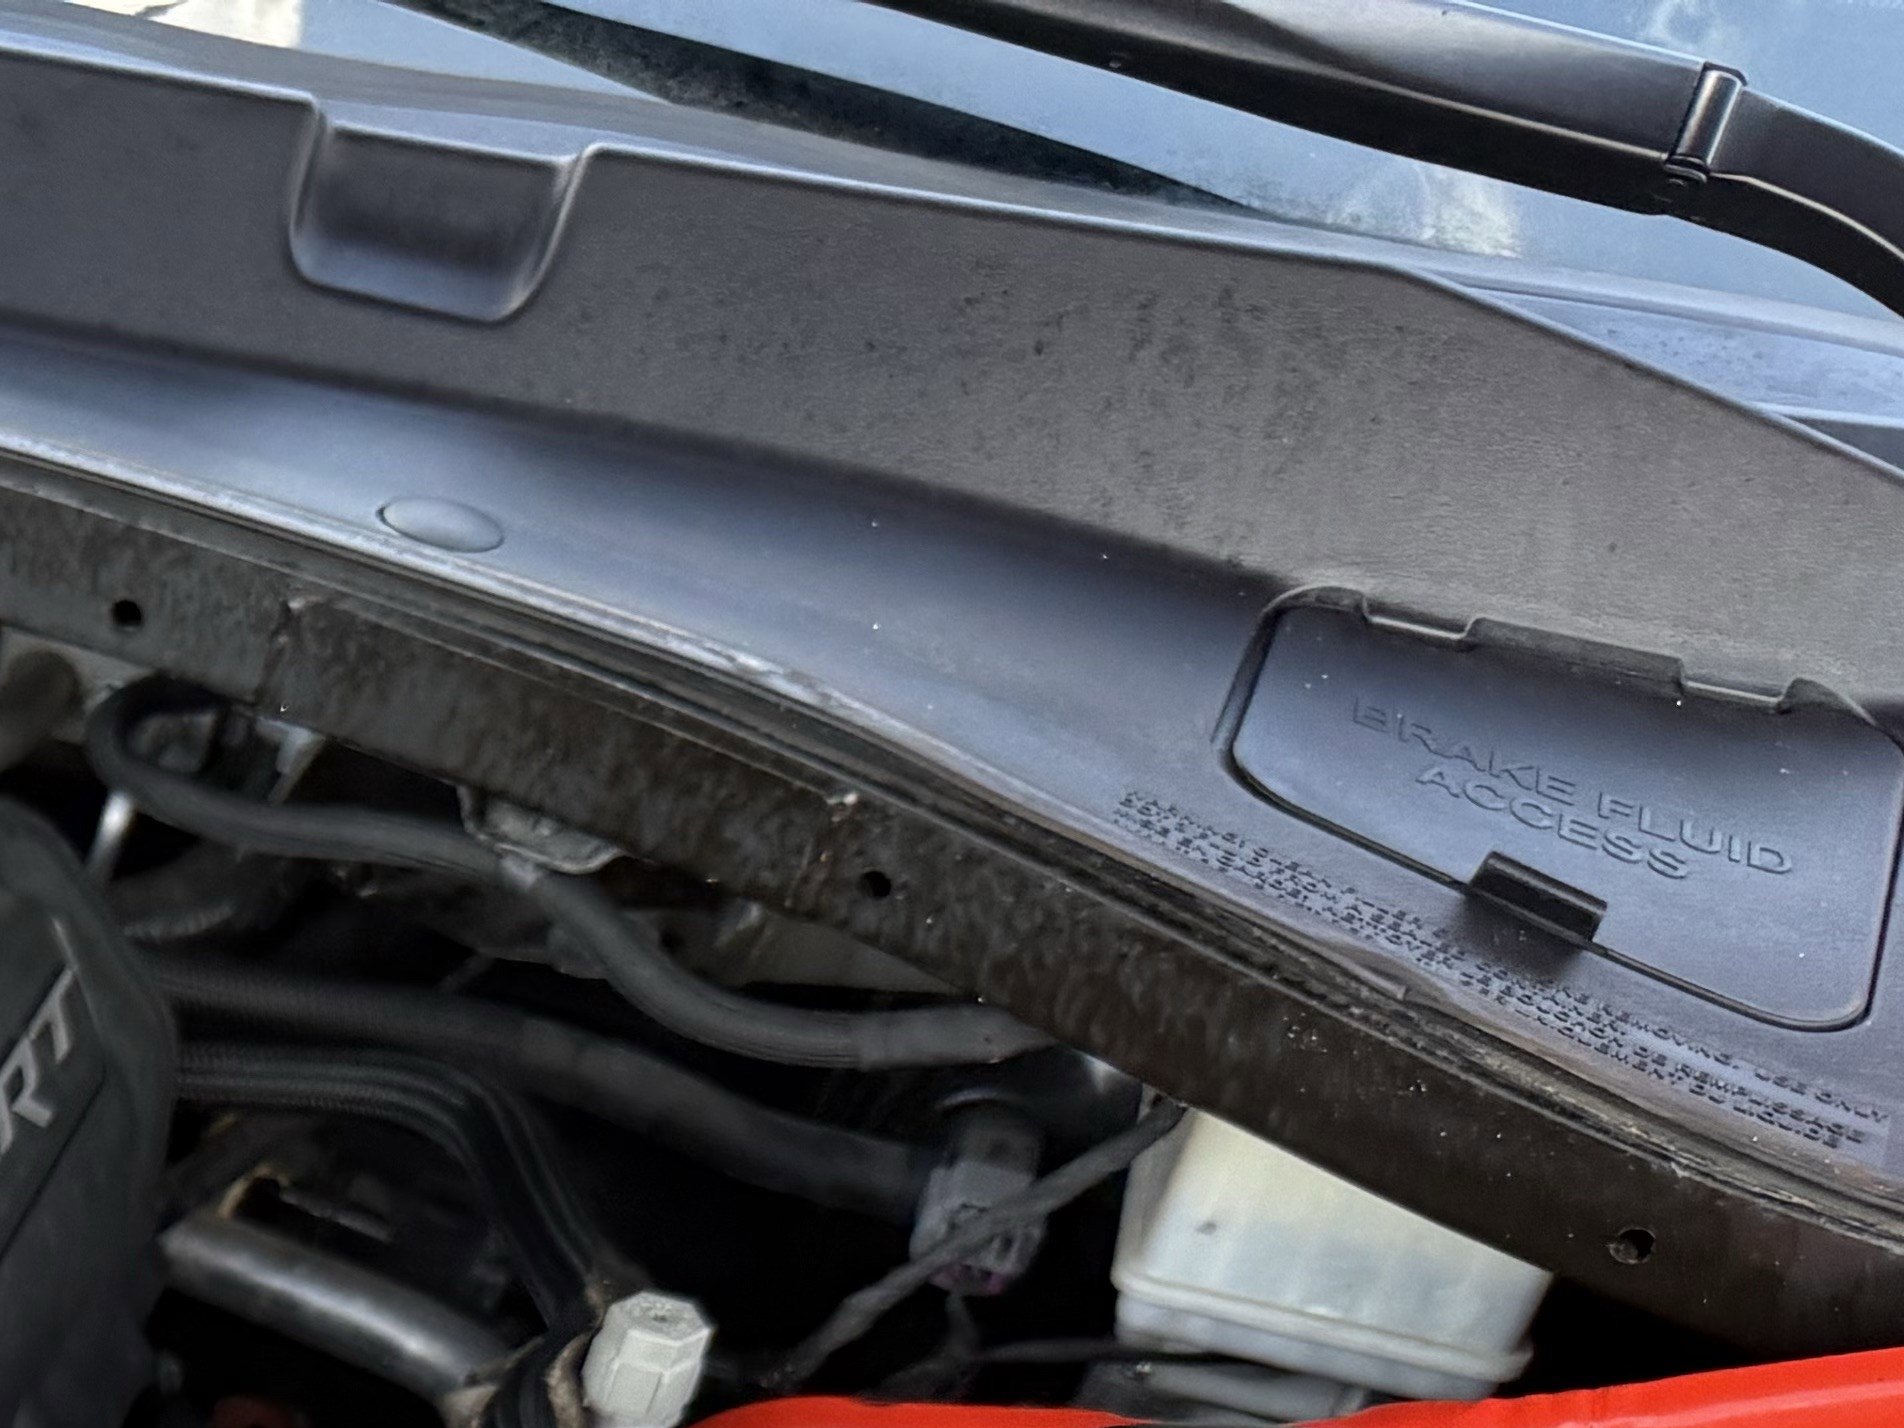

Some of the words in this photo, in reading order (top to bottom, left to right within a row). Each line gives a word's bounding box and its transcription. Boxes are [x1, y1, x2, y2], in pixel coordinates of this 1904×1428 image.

[1352, 697, 1579, 806] BRAKE
[1597, 791, 1792, 875] FLUID
[1415, 767, 1690, 880] ACCESS
